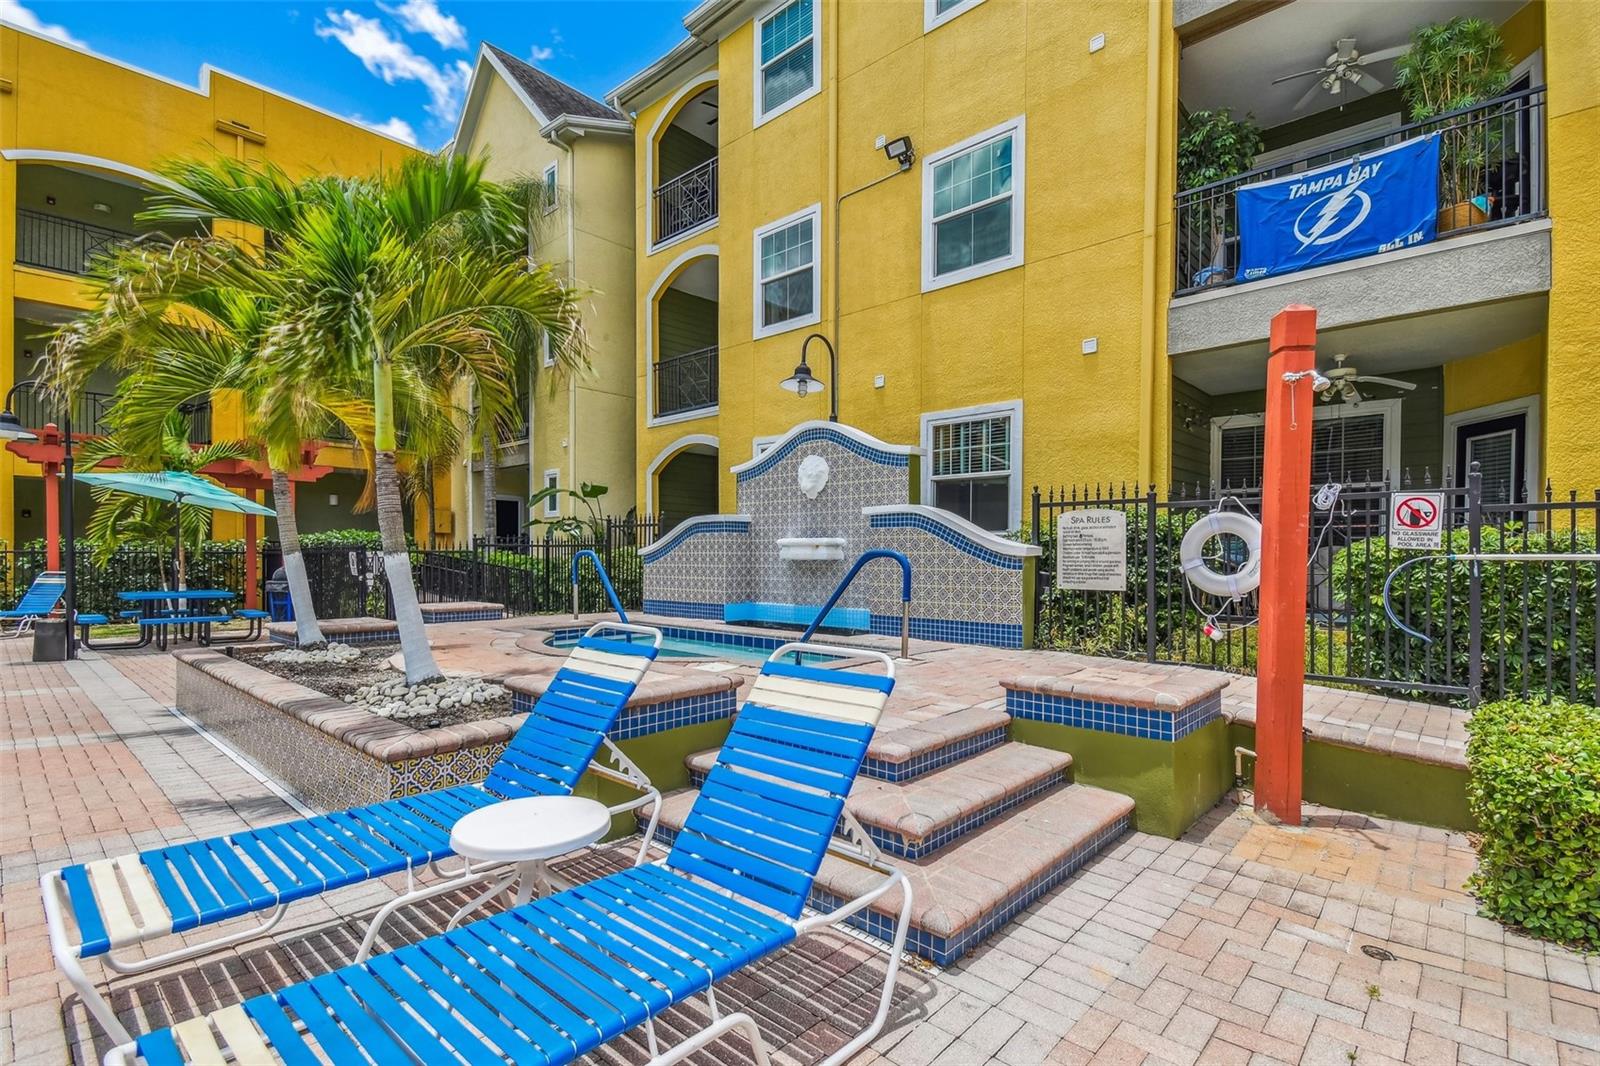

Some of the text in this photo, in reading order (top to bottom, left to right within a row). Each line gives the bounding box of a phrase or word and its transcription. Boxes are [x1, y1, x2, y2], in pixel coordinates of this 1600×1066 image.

[1289, 161, 1383, 200] TAMPA BAY
[1071, 516, 1111, 524] SPA RULES
